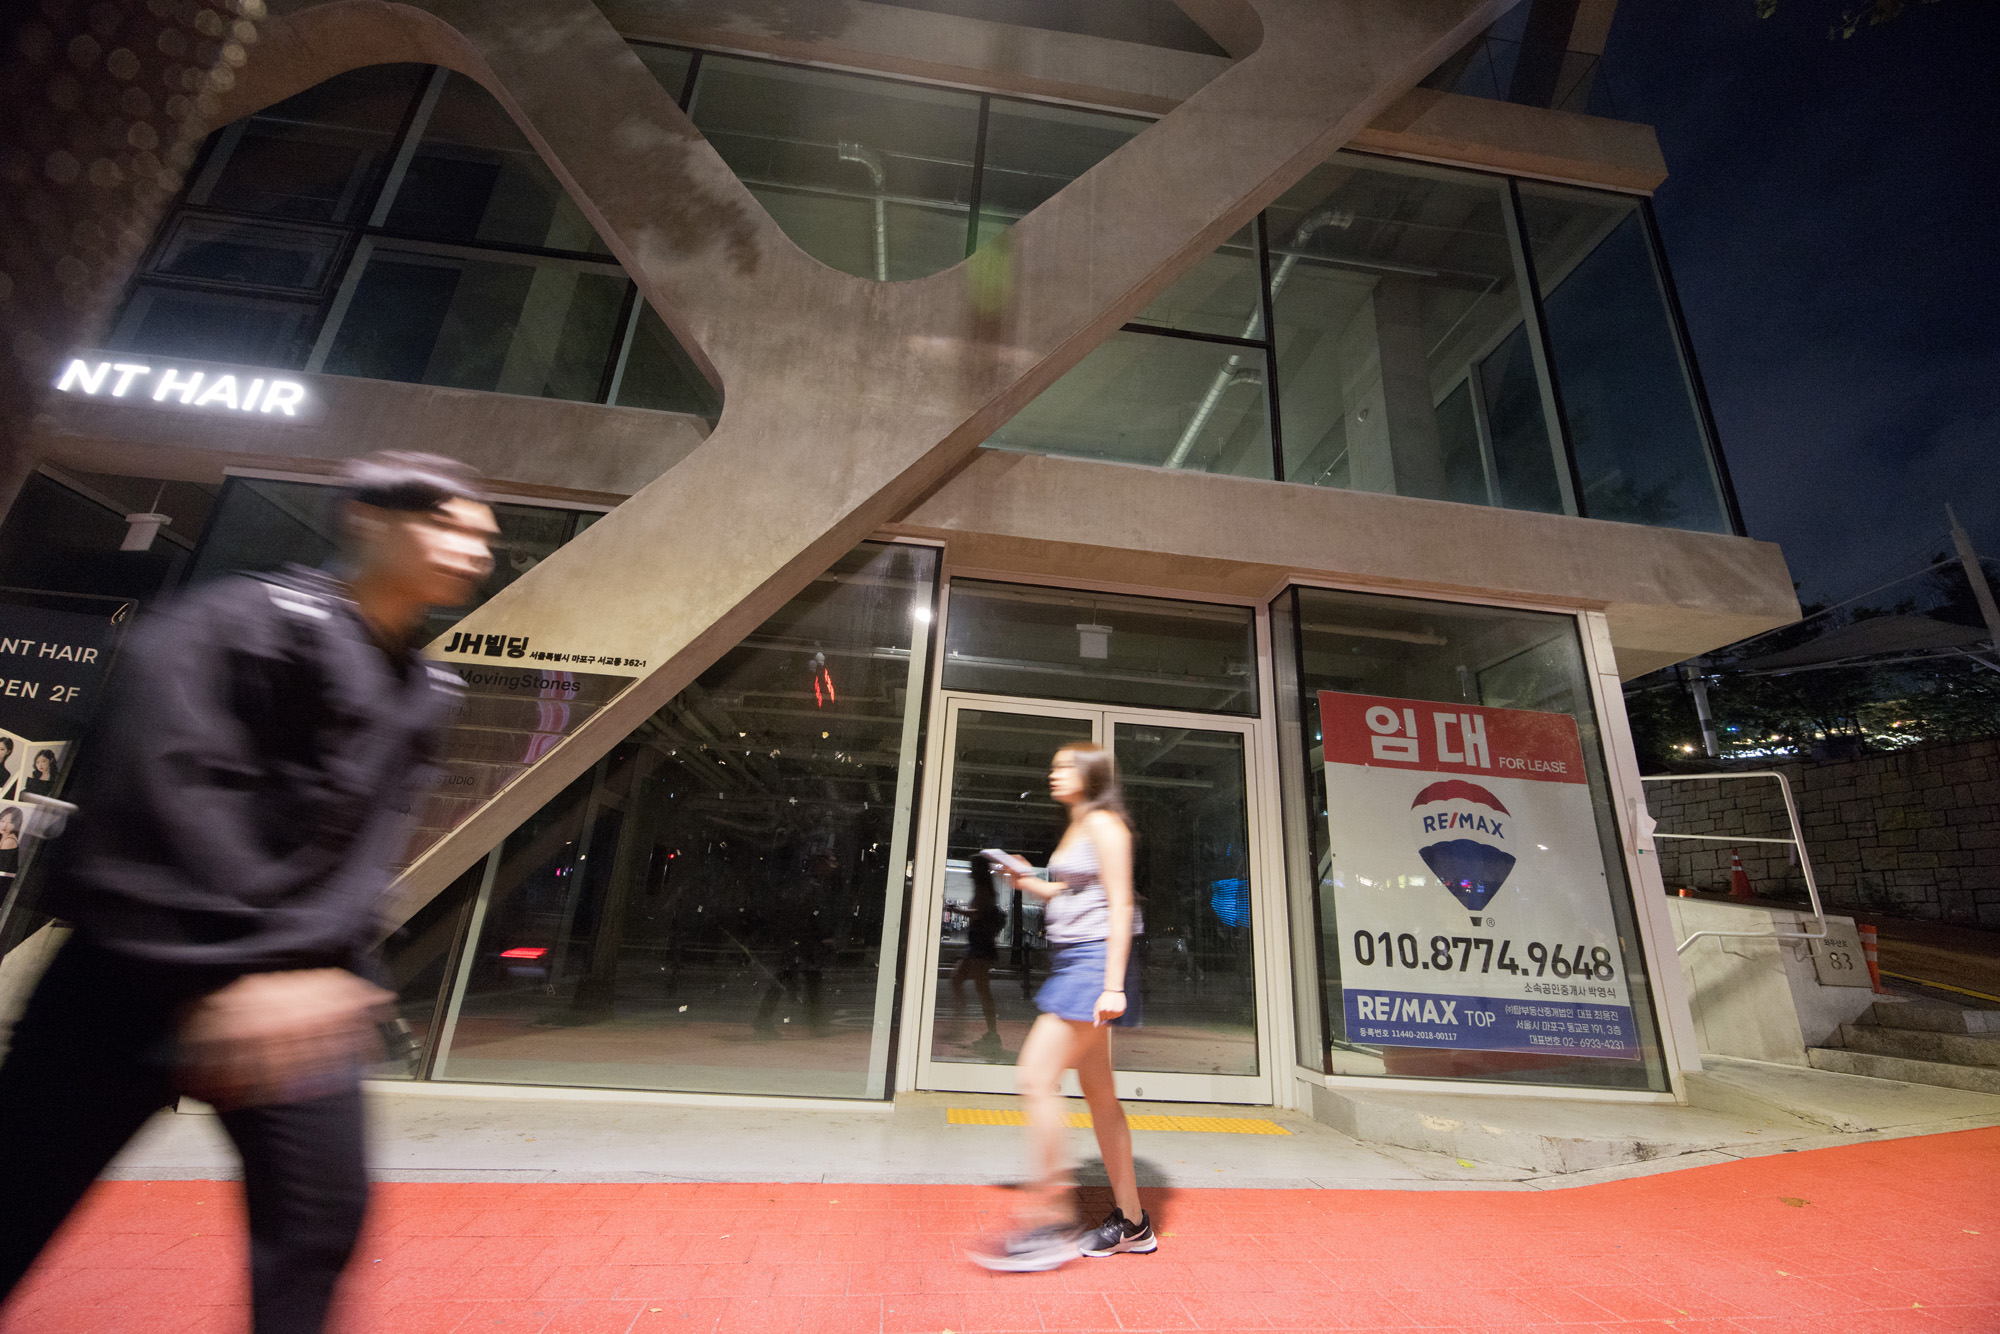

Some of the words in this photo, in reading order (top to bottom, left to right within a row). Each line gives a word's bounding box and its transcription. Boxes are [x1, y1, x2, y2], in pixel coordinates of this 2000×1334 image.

[57, 359, 151, 397] NT
[153, 369, 305, 416] HAIR
[0, 637, 36, 656] NT
[38, 642, 98, 664] HAIR
[444, 632, 529, 659] JH빌딩
[529, 651, 570, 663] 서울특별시
[572, 653, 596, 664] 마포구
[597, 656, 622, 667] 서교동
[623, 658, 647, 668] 362-1
[459, 669, 581, 692] MovingStones
[49, 684, 81, 703] 2F
[1499, 756, 1525, 771] FOR
[1528, 759, 1568, 774] LEASE
[1423, 812, 1505, 839] RE/MAX
[1353, 929, 1615, 981] 010.8774.9648
[1829, 951, 1853, 971] 83
[1524, 982, 1586, 996] 소속공인중개사
[1588, 986, 1617, 998] 박영식
[1357, 995, 1459, 1025] RE/MAX
[1464, 1010, 1496, 1027] TOP
[1577, 1009, 1593, 1019] 대표
[1594, 1010, 1620, 1021] 최용진
[1359, 1027, 1390, 1038] 등록번호
[1391, 1030, 1457, 1042] 11440-2018-00117
[1516, 1020, 1540, 1031] 서울시
[1541, 1021, 1565, 1032] 마포구
[1567, 1022, 1590, 1033] 동교로
[1607, 1025, 1622, 1036] 3층
[1529, 1034, 1562, 1046] 대표번호
